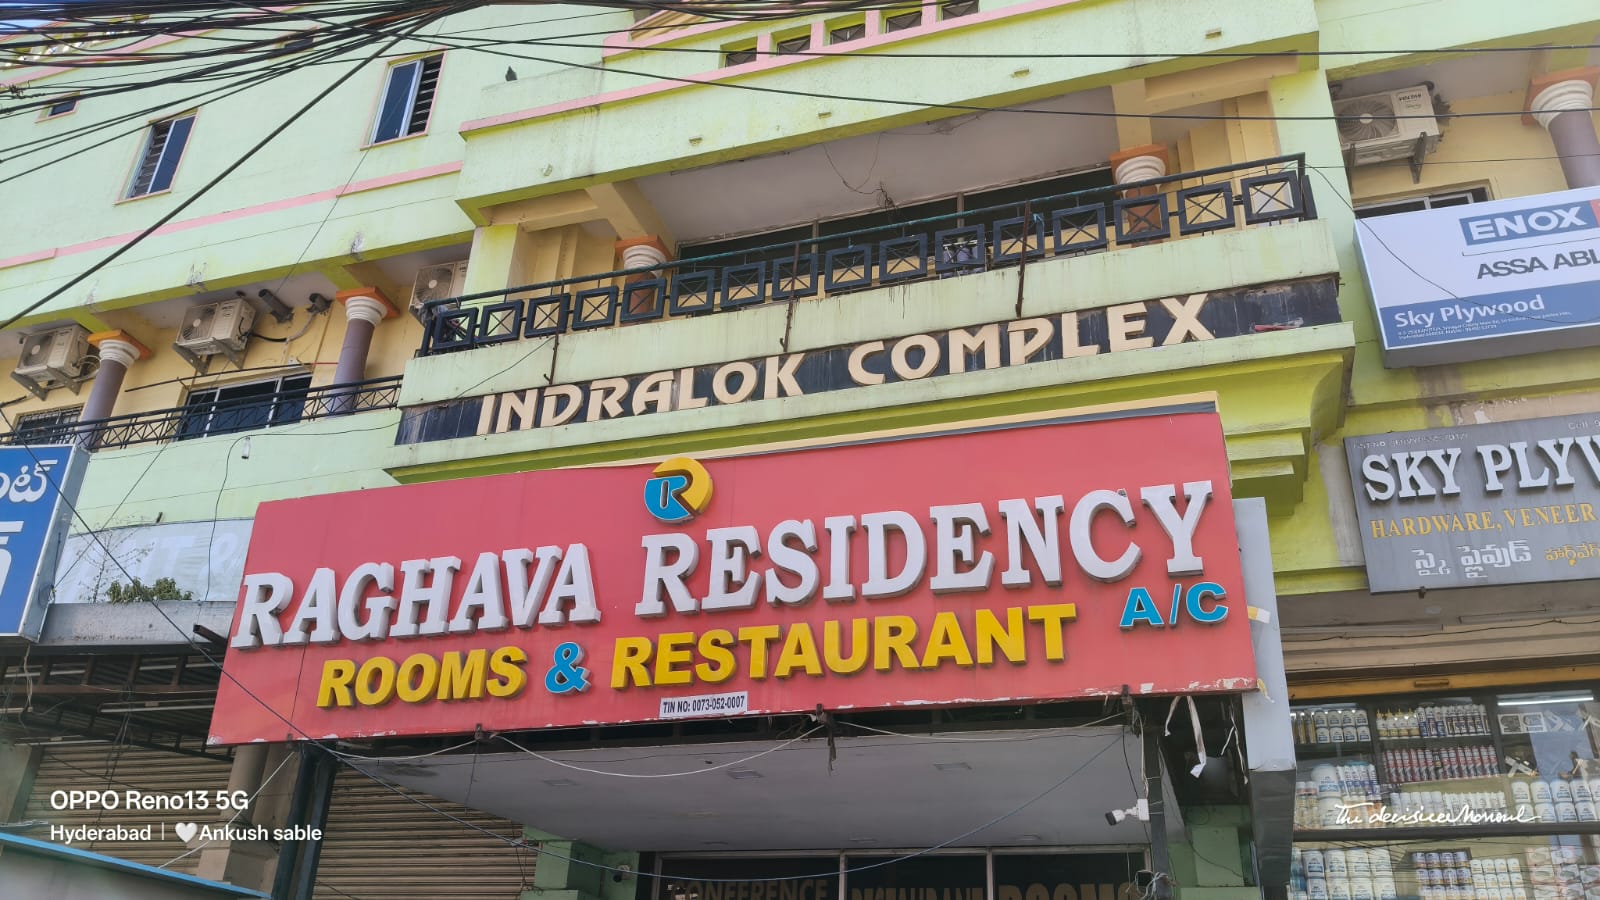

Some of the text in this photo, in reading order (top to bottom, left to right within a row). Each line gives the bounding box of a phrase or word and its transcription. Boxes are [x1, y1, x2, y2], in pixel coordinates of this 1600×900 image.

[1468, 206, 1587, 241] ENOX
[1477, 256, 1548, 279] ASSA
[1394, 310, 1435, 328] Sky
[1440, 294, 1545, 323] Plywood
[476, 293, 1215, 436] INDRALOK COMPLEX
[1362, 447, 1462, 502] SKY
[1370, 502, 1597, 540] HARDWARE, VENEER
[230, 543, 602, 650] RAGHAVA
[634, 480, 1213, 618] RESIDENCY
[1119, 582, 1230, 630] A/C
[316, 603, 1077, 709] ROOMS & RESTAURANT
[663, 695, 745, 713] TIN NO: 0073-052-0007
